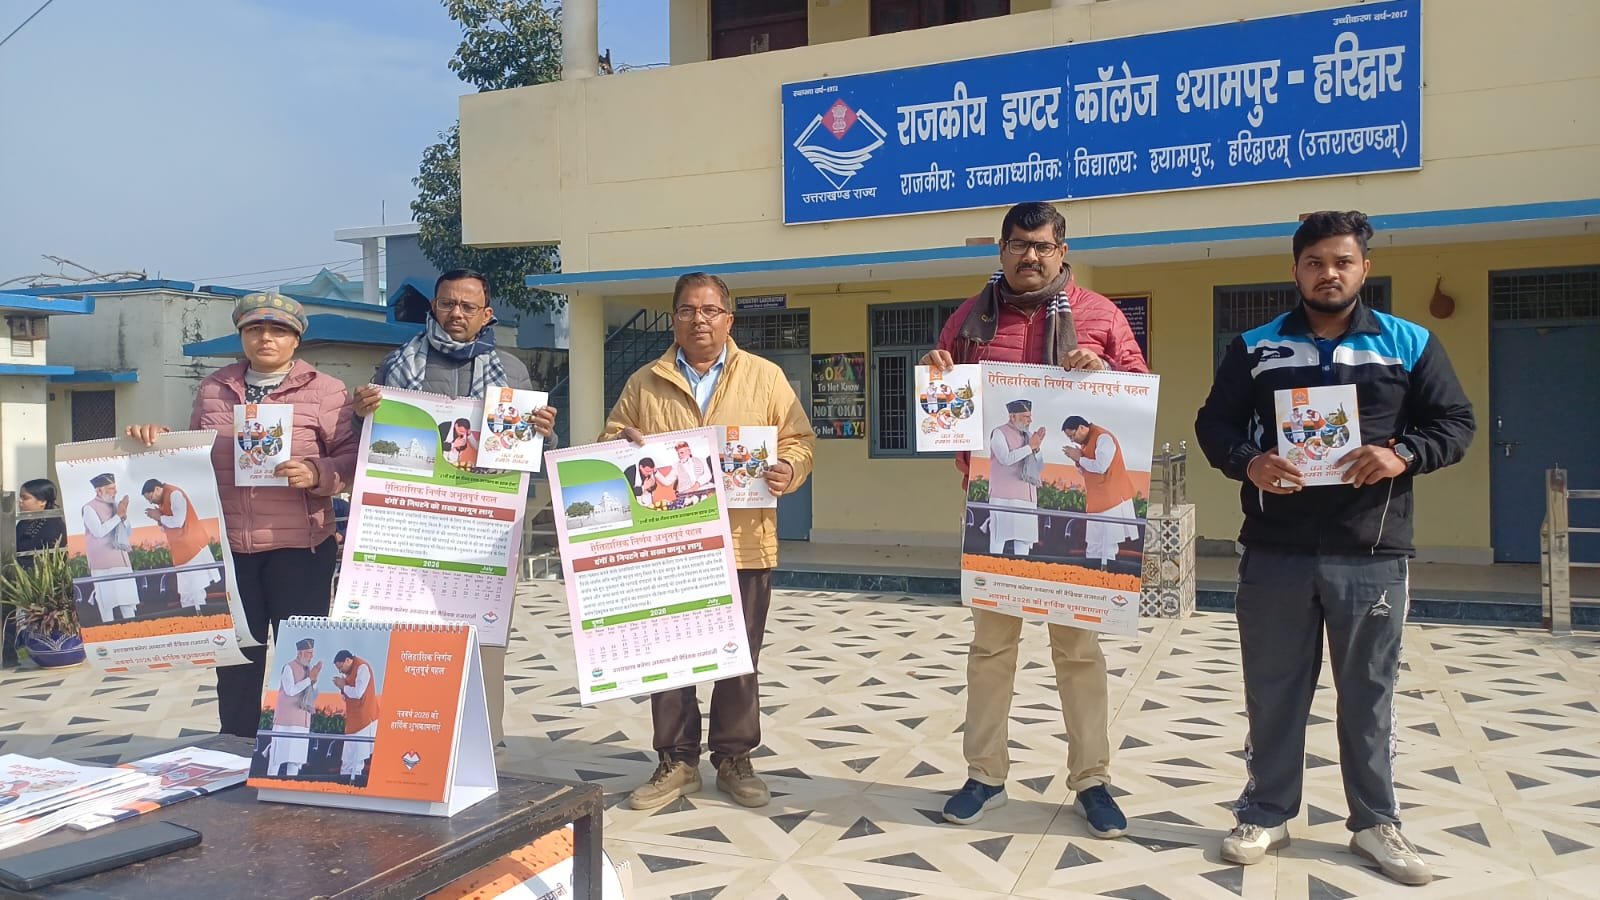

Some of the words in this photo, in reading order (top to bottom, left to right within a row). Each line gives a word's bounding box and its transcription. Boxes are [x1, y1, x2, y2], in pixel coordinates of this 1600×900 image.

[897, 81, 988, 146] राजकीय
[1001, 87, 1062, 140] इण्टर
[1074, 61, 1159, 124] कॉलेज
[1176, 59, 1281, 127] श्यामपुर
[1313, 32, 1406, 104] हरिद्वार
[1149, 142, 1215, 177] श्यामपुर,
[1227, 129, 1292, 169] हरिद्वारम्
[1298, 120, 1408, 160] (उत्तराखण्डम्)
[801, 190, 851, 204] उत्तराखण्ड
[853, 186, 877, 200] राज्य
[825, 364, 863, 382] OKAY
[818, 383, 826, 392] To
[827, 383, 839, 392] Not
[840, 382, 860, 392] Know
[987, 371, 1041, 388] ऐतिहासिक
[1044, 374, 1074, 390] निर्णय
[1077, 380, 1121, 397] अभूतपूर्व
[1123, 385, 1150, 396] पहल
[813, 405, 834, 417] NOT
[837, 405, 863, 417] OKAY
[822, 426, 834, 435] Not
[834, 420, 865, 437] TRY!
[423, 560, 440, 568] 2026
[649, 608, 667, 616] 2026
[400, 650, 433, 663] ऐतिहासिक
[434, 651, 453, 662] निर्णय
[404, 664, 430, 676] अभूतपूर्व
[430, 666, 447, 675] पहल
[396, 708, 413, 719] नववर्ष
[430, 709, 439, 719] की
[391, 719, 408, 730] हार्दिक
